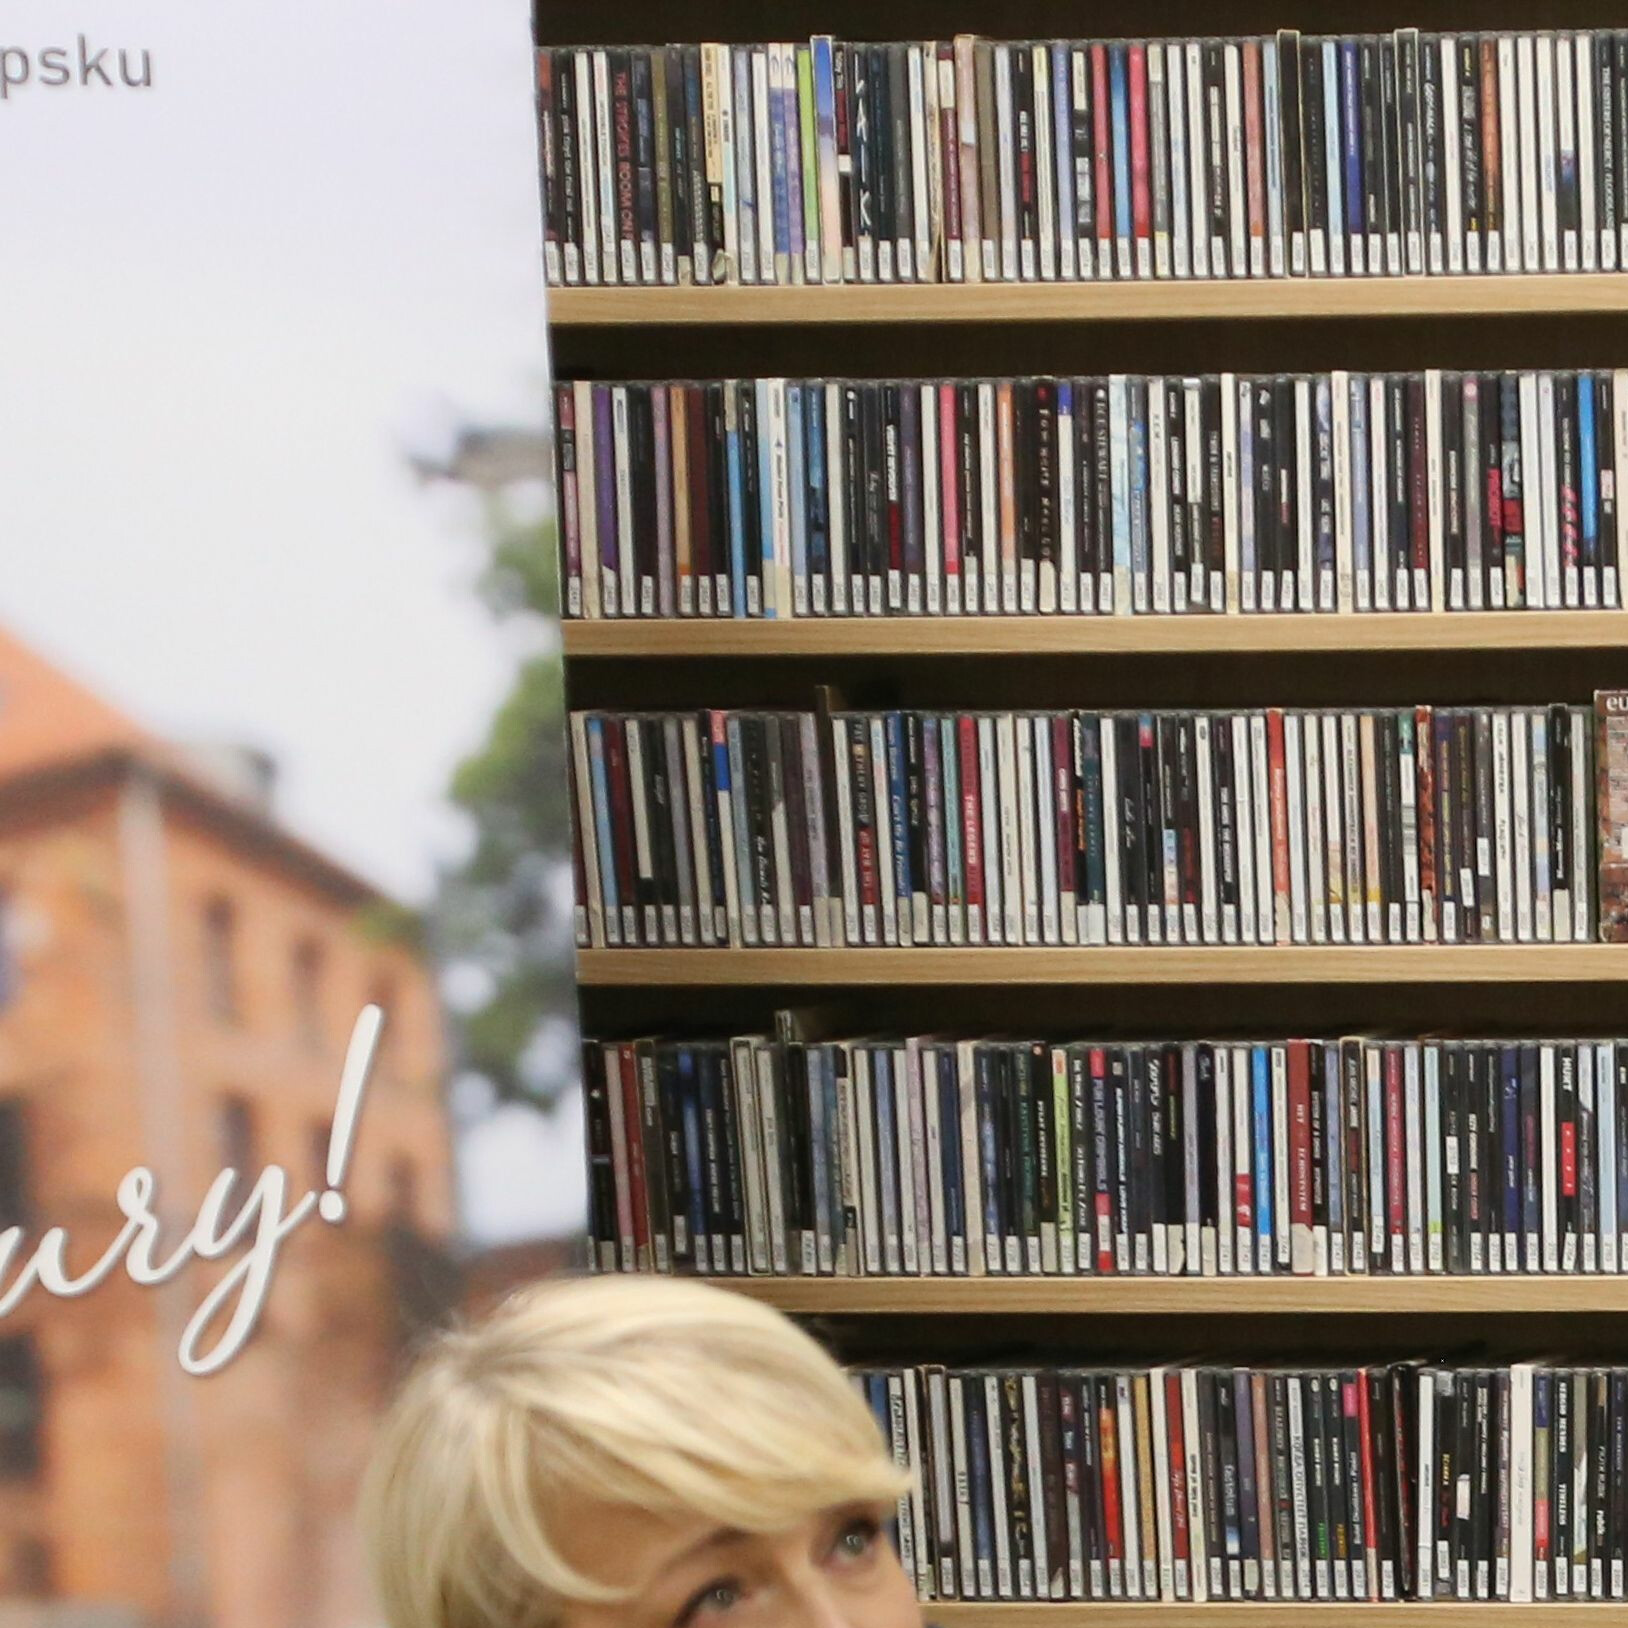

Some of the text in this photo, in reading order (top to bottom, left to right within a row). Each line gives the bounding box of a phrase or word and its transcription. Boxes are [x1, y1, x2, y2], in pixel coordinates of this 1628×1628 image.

[615, 71, 628, 96] THE
[1602, 66, 1611, 84] THE
[1602, 85, 1612, 123] SISTERS
[616, 102, 630, 156] STROKES
[1604, 135, 1612, 169] MERCY
[618, 161, 632, 208] ROOM
[1296, 1104, 1305, 1123] HEY
